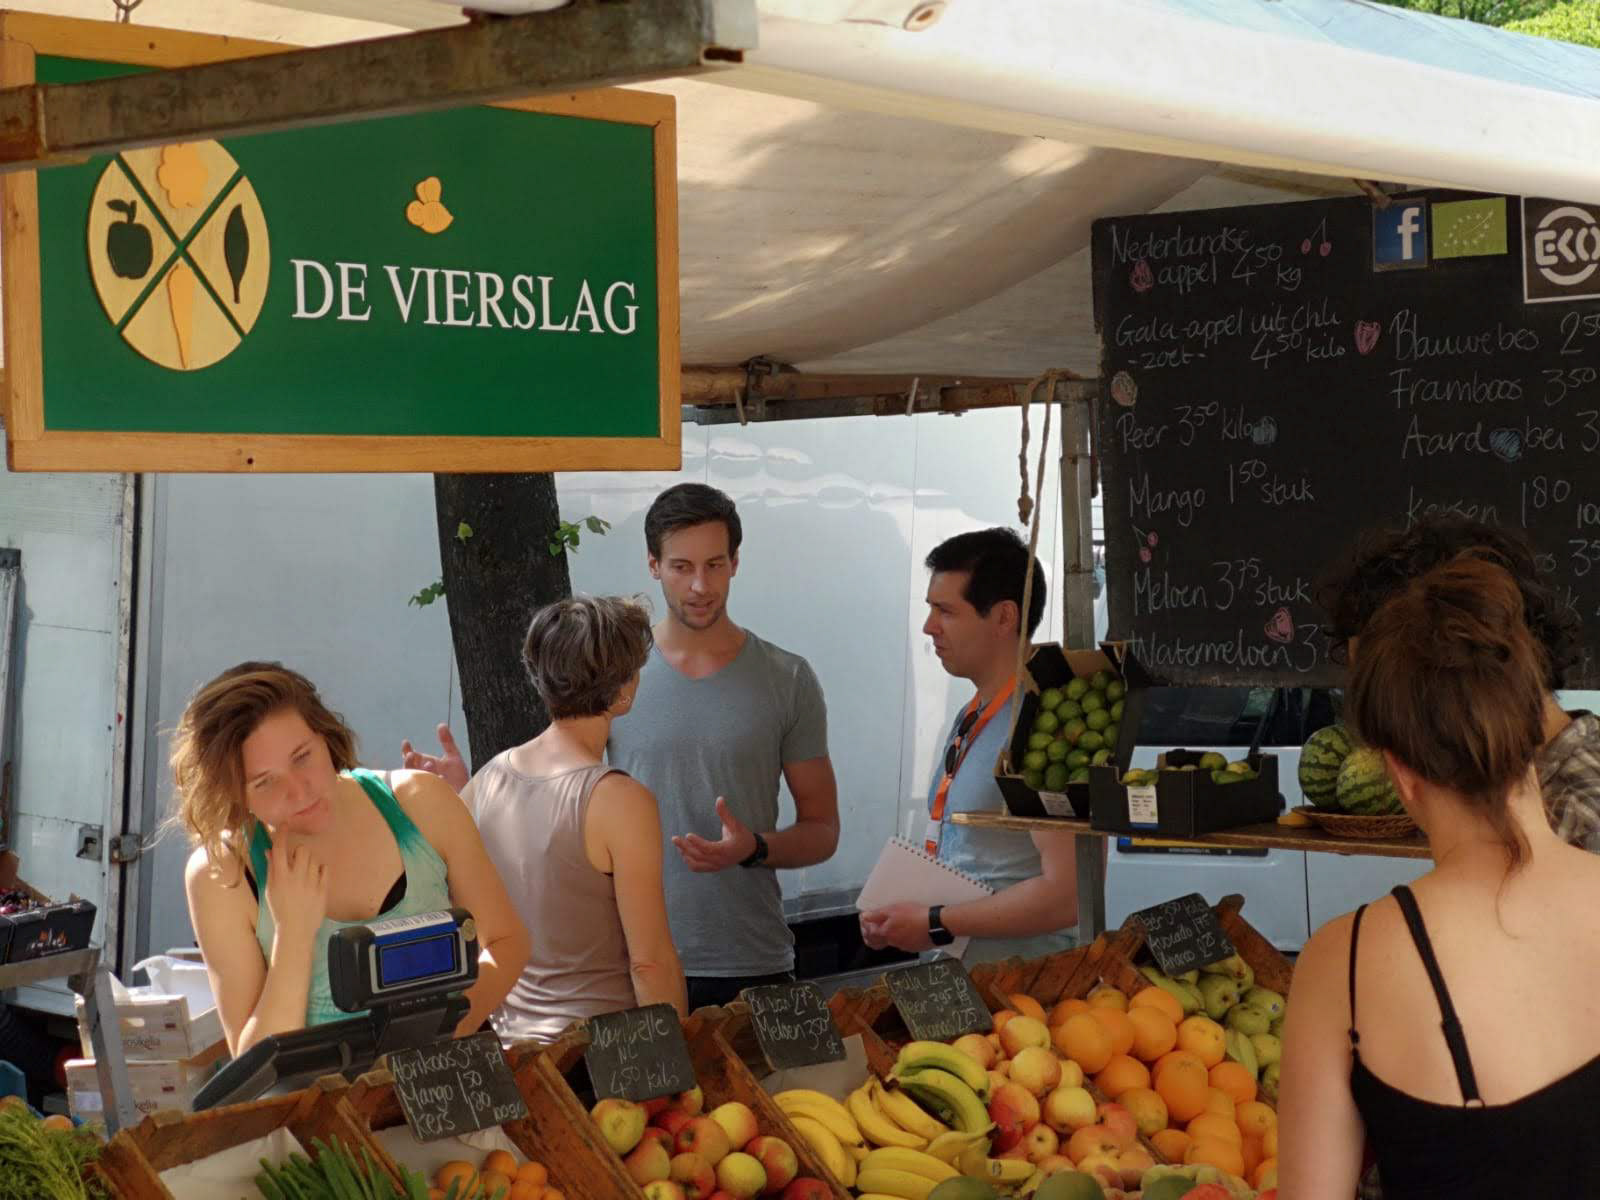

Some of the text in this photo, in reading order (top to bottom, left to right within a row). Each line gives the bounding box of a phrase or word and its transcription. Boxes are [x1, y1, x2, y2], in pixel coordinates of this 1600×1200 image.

[290, 259, 639, 335] DE VIERSLAG
[1158, 256, 1216, 295] appel
[1116, 412, 1168, 455] Peer
[1128, 471, 1207, 527] Mango
[1133, 569, 1208, 616] Meloen
[399, 1080, 454, 1112] Mango
